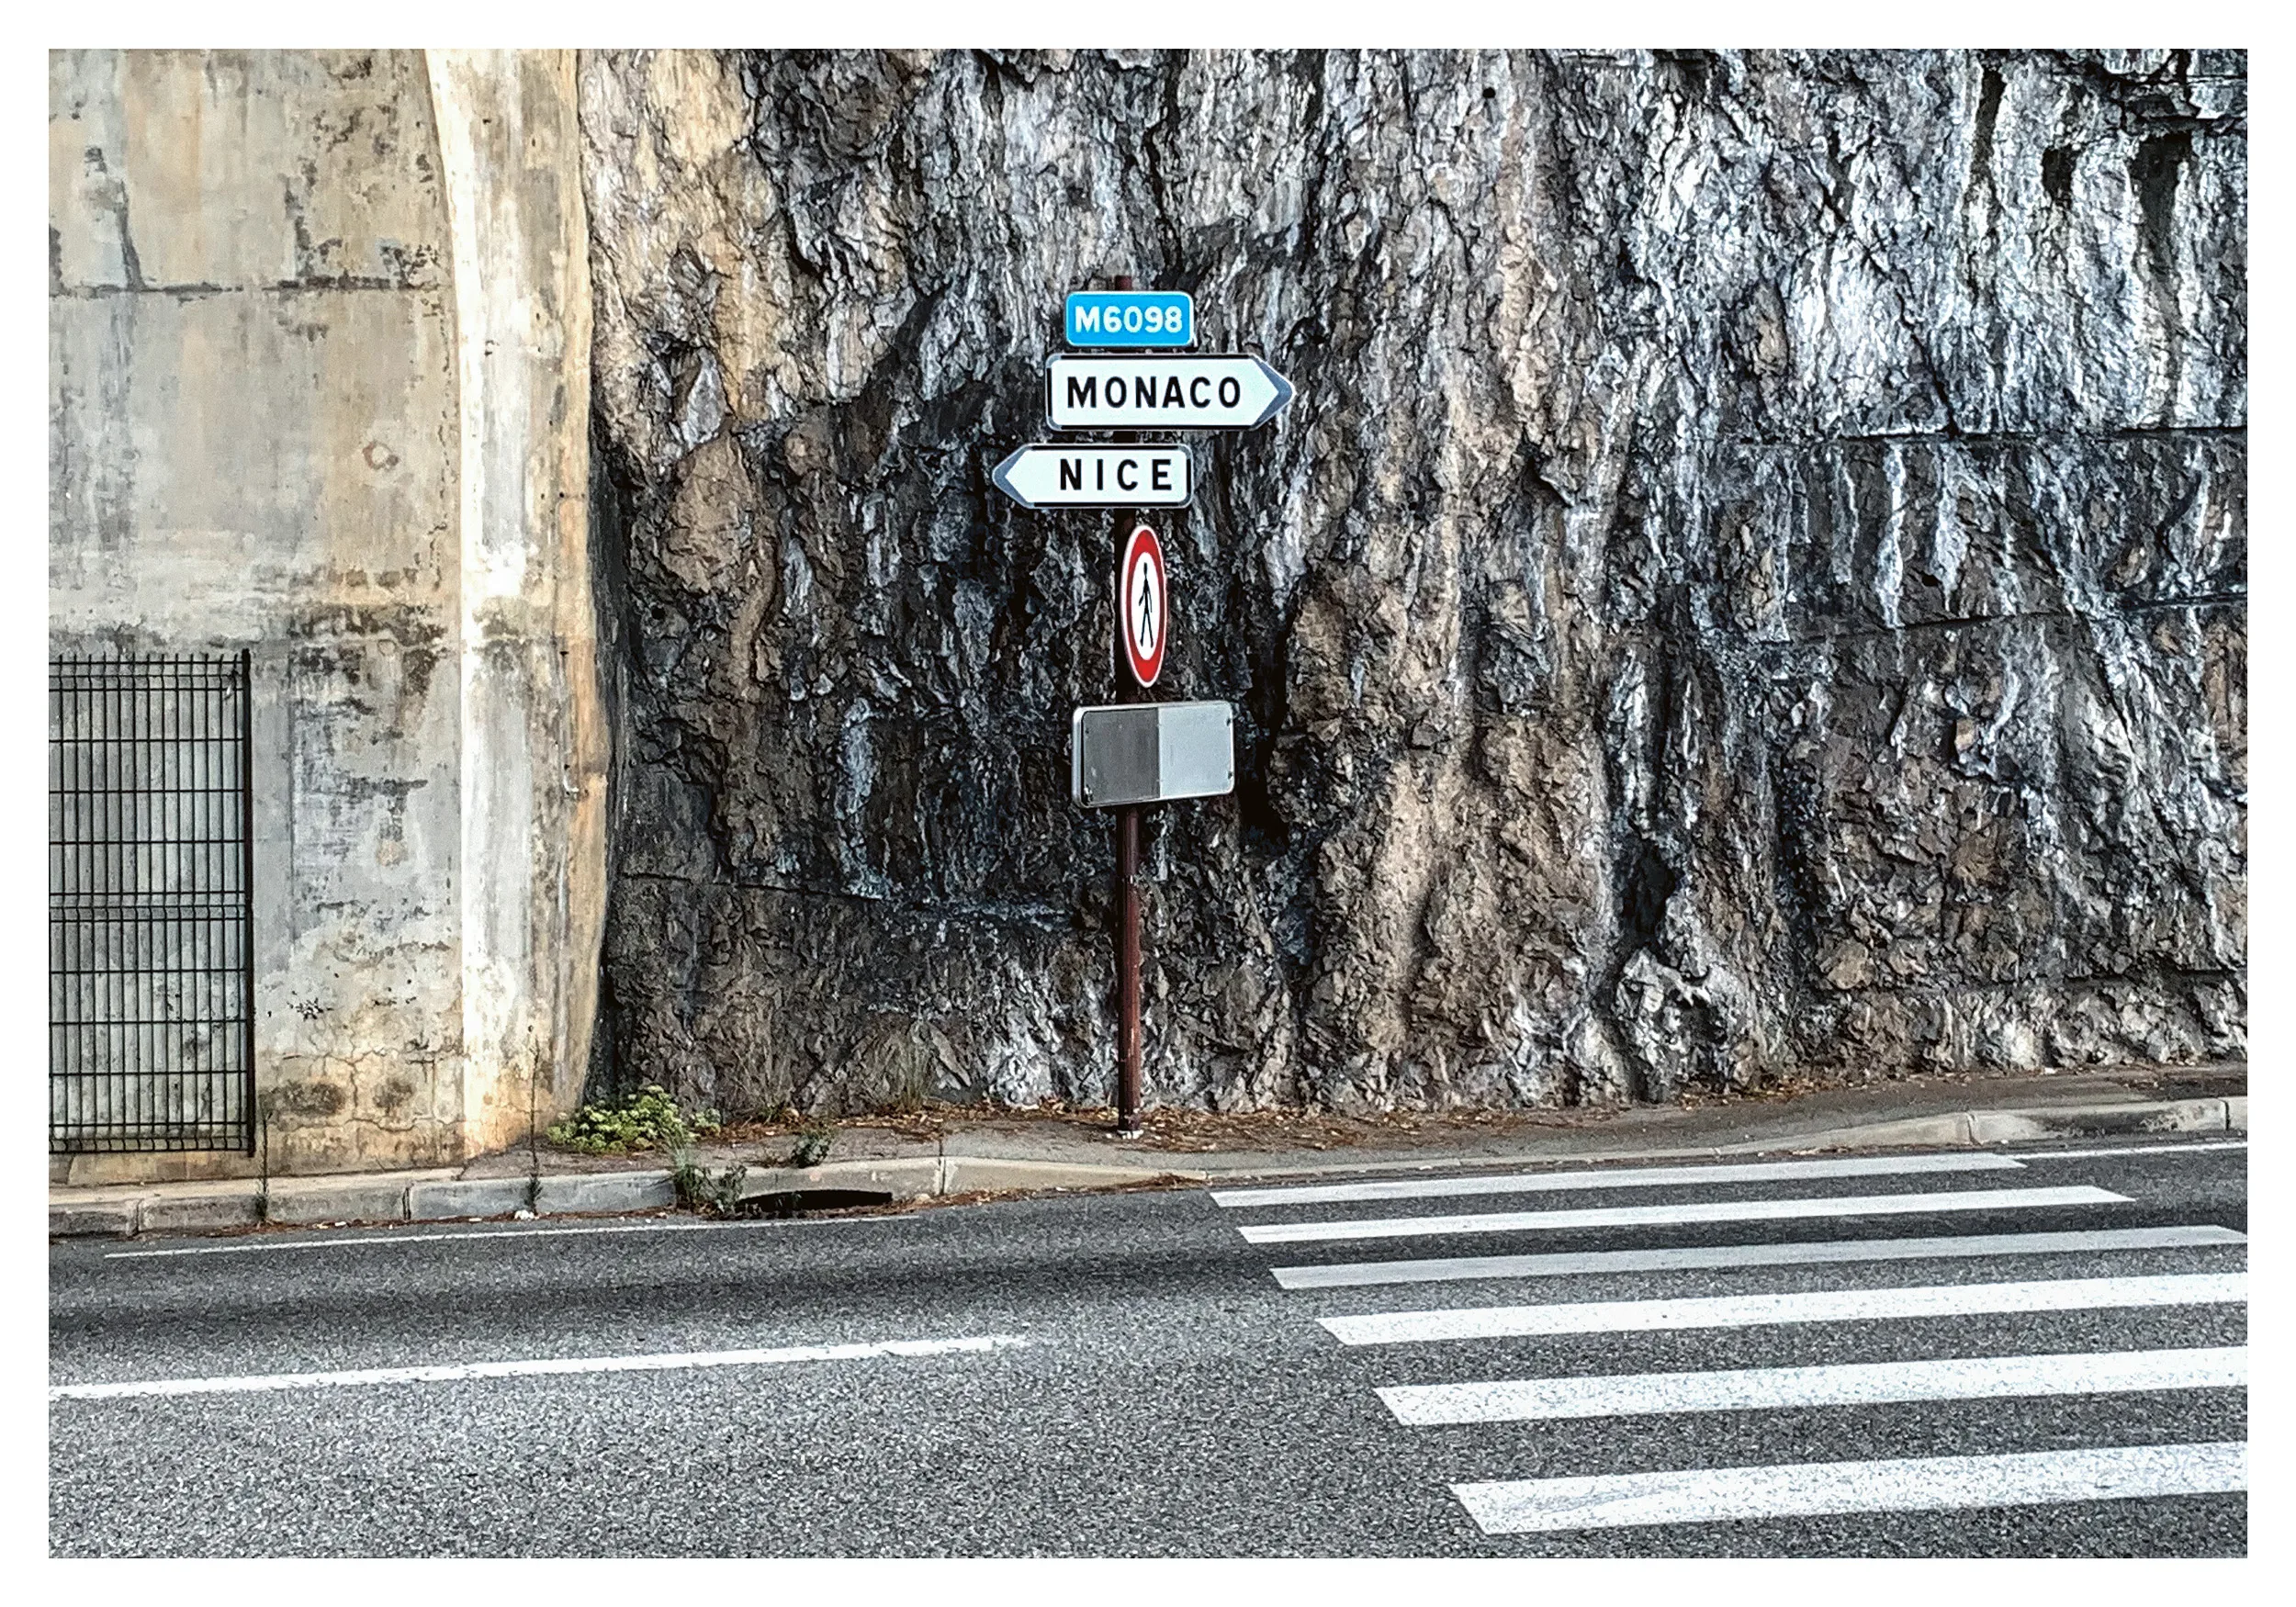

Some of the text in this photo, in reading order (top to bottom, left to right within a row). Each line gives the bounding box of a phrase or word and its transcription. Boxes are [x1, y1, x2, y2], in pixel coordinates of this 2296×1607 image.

[1075, 306, 1183, 333] M6098
[1066, 376, 1241, 409] MONACO
[1059, 458, 1172, 490] NICE
